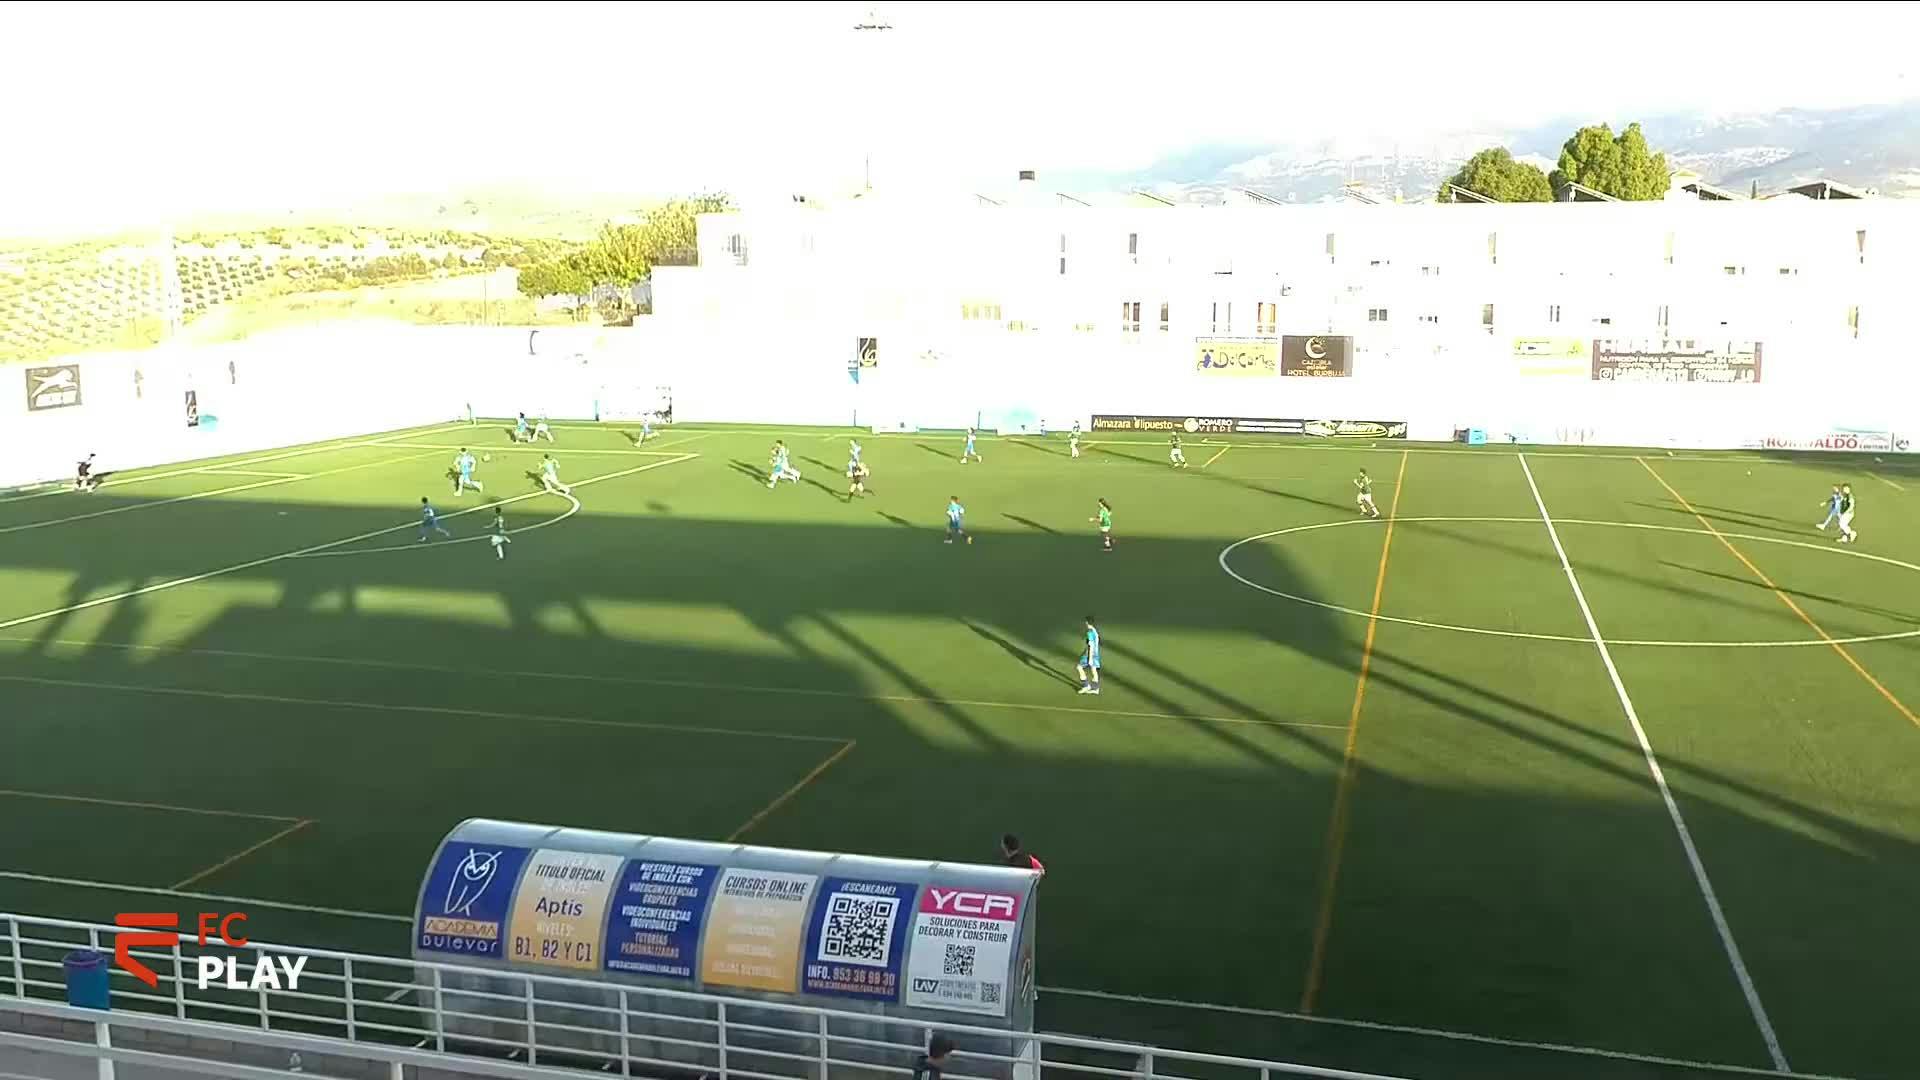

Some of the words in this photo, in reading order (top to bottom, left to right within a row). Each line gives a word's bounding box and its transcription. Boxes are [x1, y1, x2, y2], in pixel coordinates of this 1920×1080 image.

[1093, 417, 1131, 429] Almazara
[1198, 418, 1233, 426] ROMERO
[569, 867, 606, 881] OFICIAL
[640, 863, 676, 874] NUESTROS
[676, 865, 704, 877] CURSOS
[629, 882, 699, 898] VIDEOCONFERENCIAS
[725, 875, 768, 891] CURSOS
[769, 880, 808, 895] ONLINE
[535, 896, 583, 918] Aptis
[930, 889, 1015, 917] YCR
[622, 904, 692, 922] VIDEOCONFERENCIAS
[426, 918, 497, 938] ACADEMIA
[929, 916, 977, 930] SOLUCIONES
[979, 920, 1000, 932] PARA
[919, 925, 954, 939] DECORAR
[955, 929, 962, 939] Y
[965, 930, 1008, 943] CONSTRUIR
[542, 938, 557, 960] B2
[564, 941, 573, 960] Y
[576, 942, 592, 962] C1
[808, 964, 831, 980] INFO.
[833, 967, 850, 981] 953
[853, 968, 866, 983] 36
